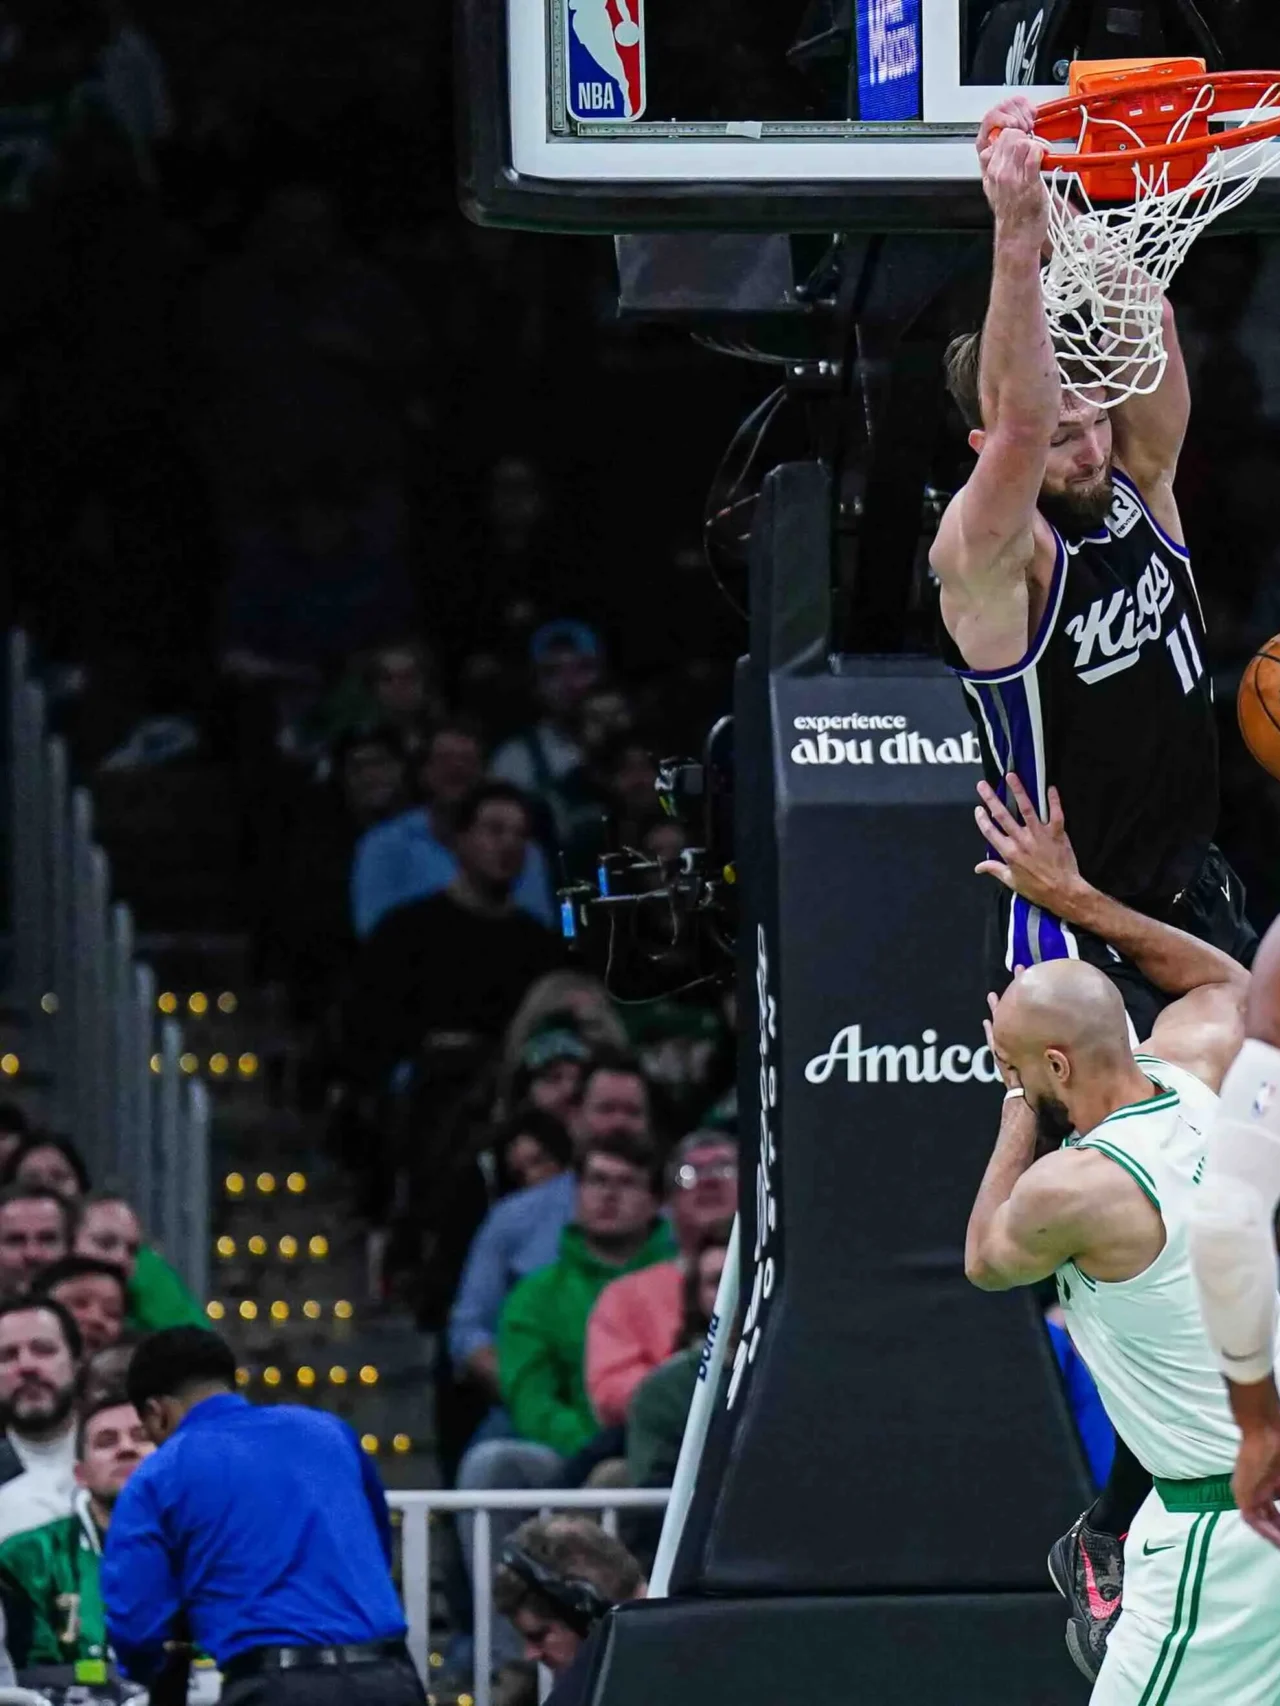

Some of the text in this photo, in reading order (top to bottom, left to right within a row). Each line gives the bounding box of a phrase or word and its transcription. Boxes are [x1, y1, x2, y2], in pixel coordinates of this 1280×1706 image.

[578, 82, 615, 110] NBA
[1064, 551, 1174, 685] Kigs
[1165, 613, 1202, 695] 11
[793, 712, 907, 732] experience
[790, 733, 874, 765] abu
[804, 1024, 1005, 1084] Amica
